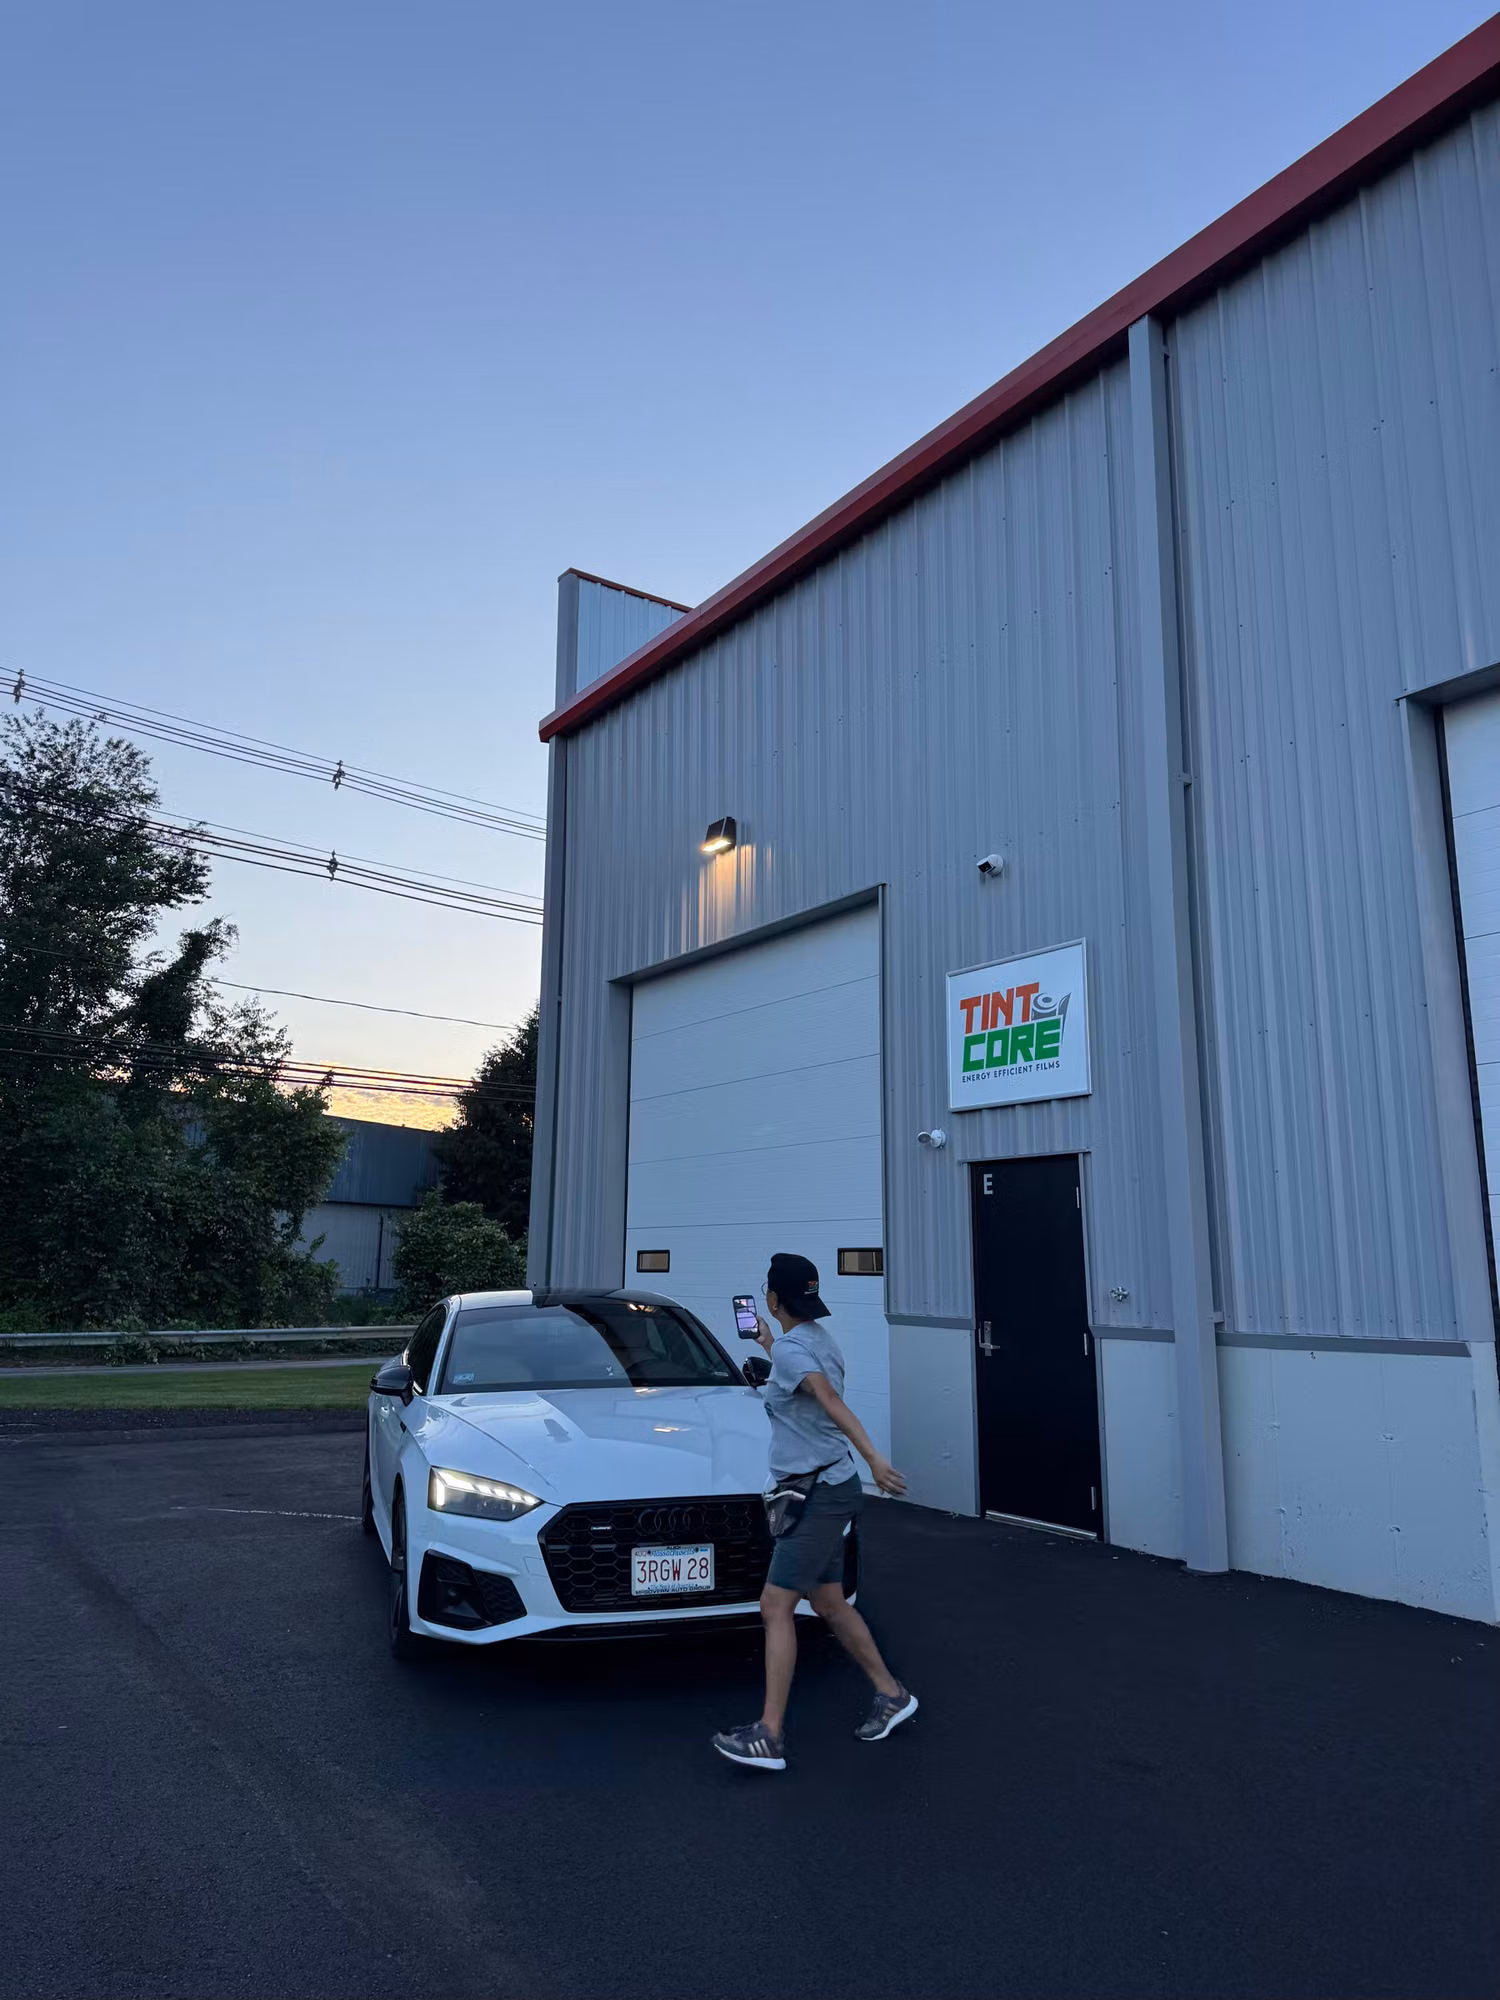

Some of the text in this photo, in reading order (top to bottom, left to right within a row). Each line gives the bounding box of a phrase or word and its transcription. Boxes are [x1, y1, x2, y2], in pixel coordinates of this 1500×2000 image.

[960, 982, 1040, 1034] TINT
[962, 1017, 1061, 1072] CORE
[962, 1060, 1060, 1083] ENERGY EFFICIENT FILMS
[983, 1173, 993, 1195] E
[637, 1557, 709, 1584] 3RGW 28
